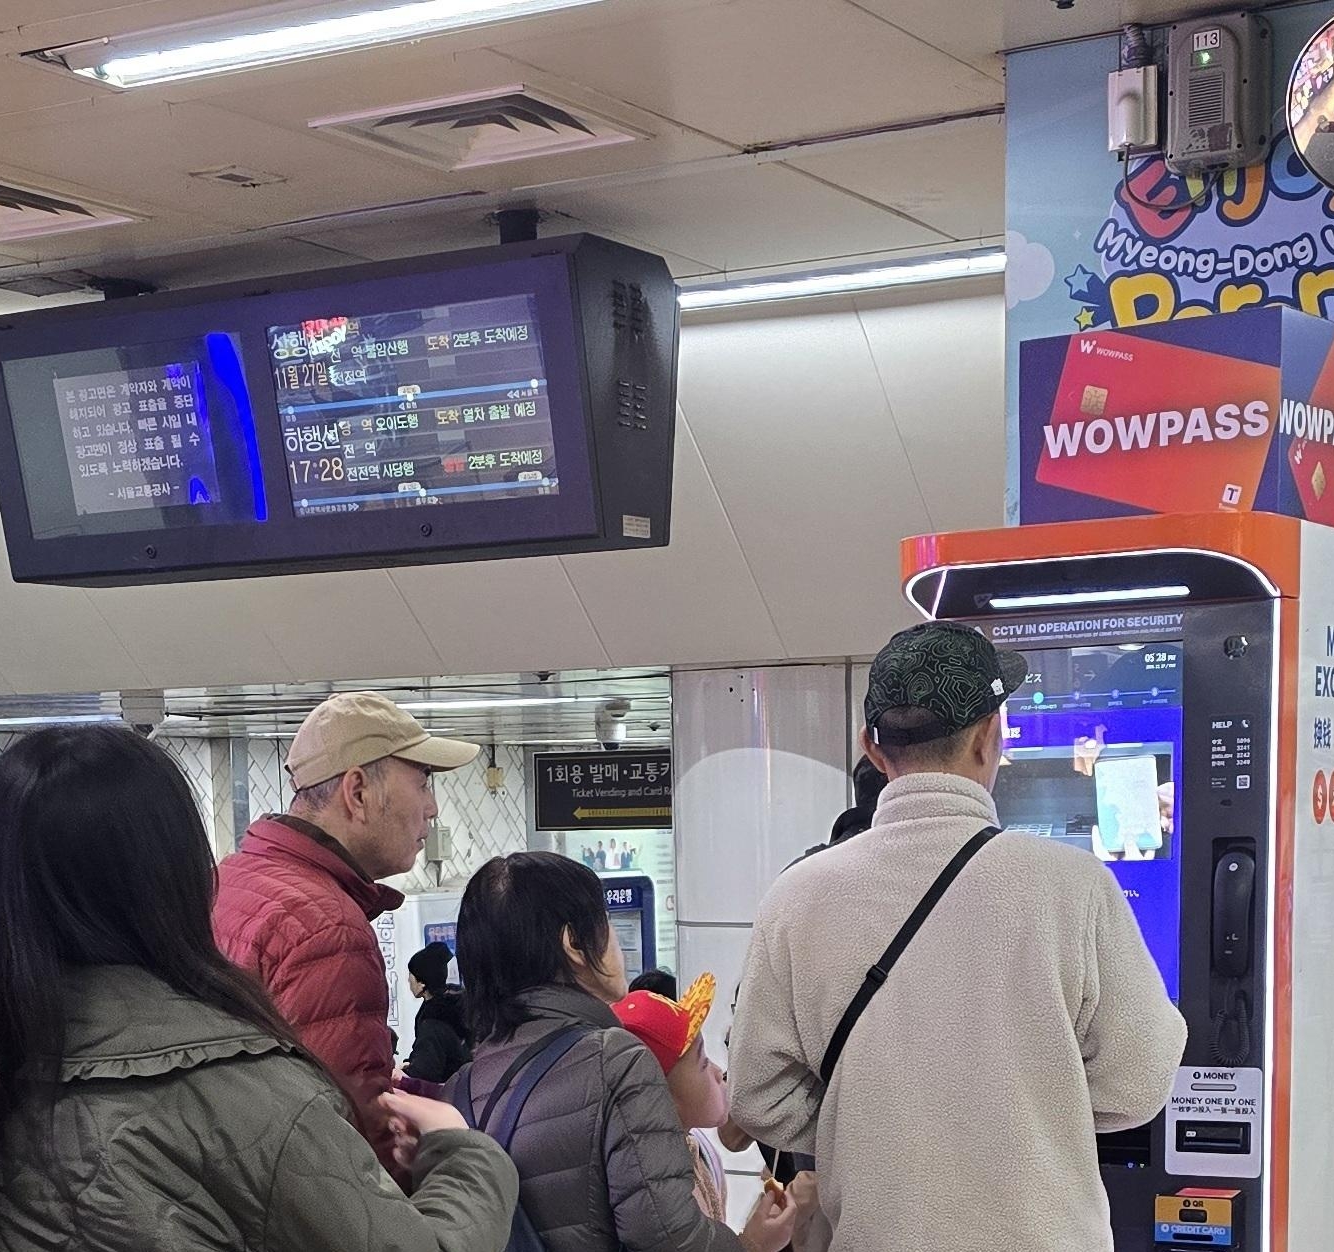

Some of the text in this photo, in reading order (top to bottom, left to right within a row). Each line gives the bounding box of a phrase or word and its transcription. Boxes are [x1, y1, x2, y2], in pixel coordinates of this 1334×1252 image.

[1195, 32, 1219, 49] 113
[1098, 222, 1313, 279] Myeong-Dong
[427, 335, 450, 350] 도착
[453, 330, 482, 348] 2분후
[485, 325, 528, 344] 도착예정
[1097, 347, 1134, 362] WOWPASS
[275, 365, 299, 390] 11월
[302, 362, 329, 387] 27일
[113, 402, 132, 416] 광고
[174, 394, 194, 409] 중단
[73, 425, 91, 439] 하고
[96, 420, 134, 437] 있습니다.
[162, 414, 182, 429] 시일
[186, 412, 198, 426] 내
[284, 423, 341, 453] 하행선
[361, 419, 373, 433] 역
[376, 413, 419, 432] 오이도행
[437, 409, 459, 425] 도착
[463, 406, 485, 423] 열차
[489, 403, 511, 420] 출발
[514, 400, 536, 417] 예정
[1043, 400, 1270, 459] WOWPASS
[117, 439, 137, 454] 정상
[144, 436, 165, 450] 표출
[171, 434, 182, 449] 될
[189, 432, 201, 446] 수
[344, 441, 377, 459] 전 역
[78, 454, 184, 478] 있도록 노력하겠습니다.
[290, 457, 344, 484] 17:28
[347, 464, 381, 481] 전전역
[382, 461, 415, 478] 사당행
[468, 454, 496, 470] 2분후
[499, 448, 543, 467] 도착예정
[993, 614, 1184, 636] CCTV IN OPERATION FOR SECURITY
[1212, 720, 1233, 729] HELP
[547, 764, 585, 785] 1회용
[571, 786, 663, 798] Ticket Vending and Card
[1203, 1072, 1236, 1080] MONEY
[1171, 1096, 1257, 1107] MONEY ONE BY ONE
[1192, 1200, 1204, 1208] QR
[1171, 1224, 1226, 1236] CREDIT CARD
